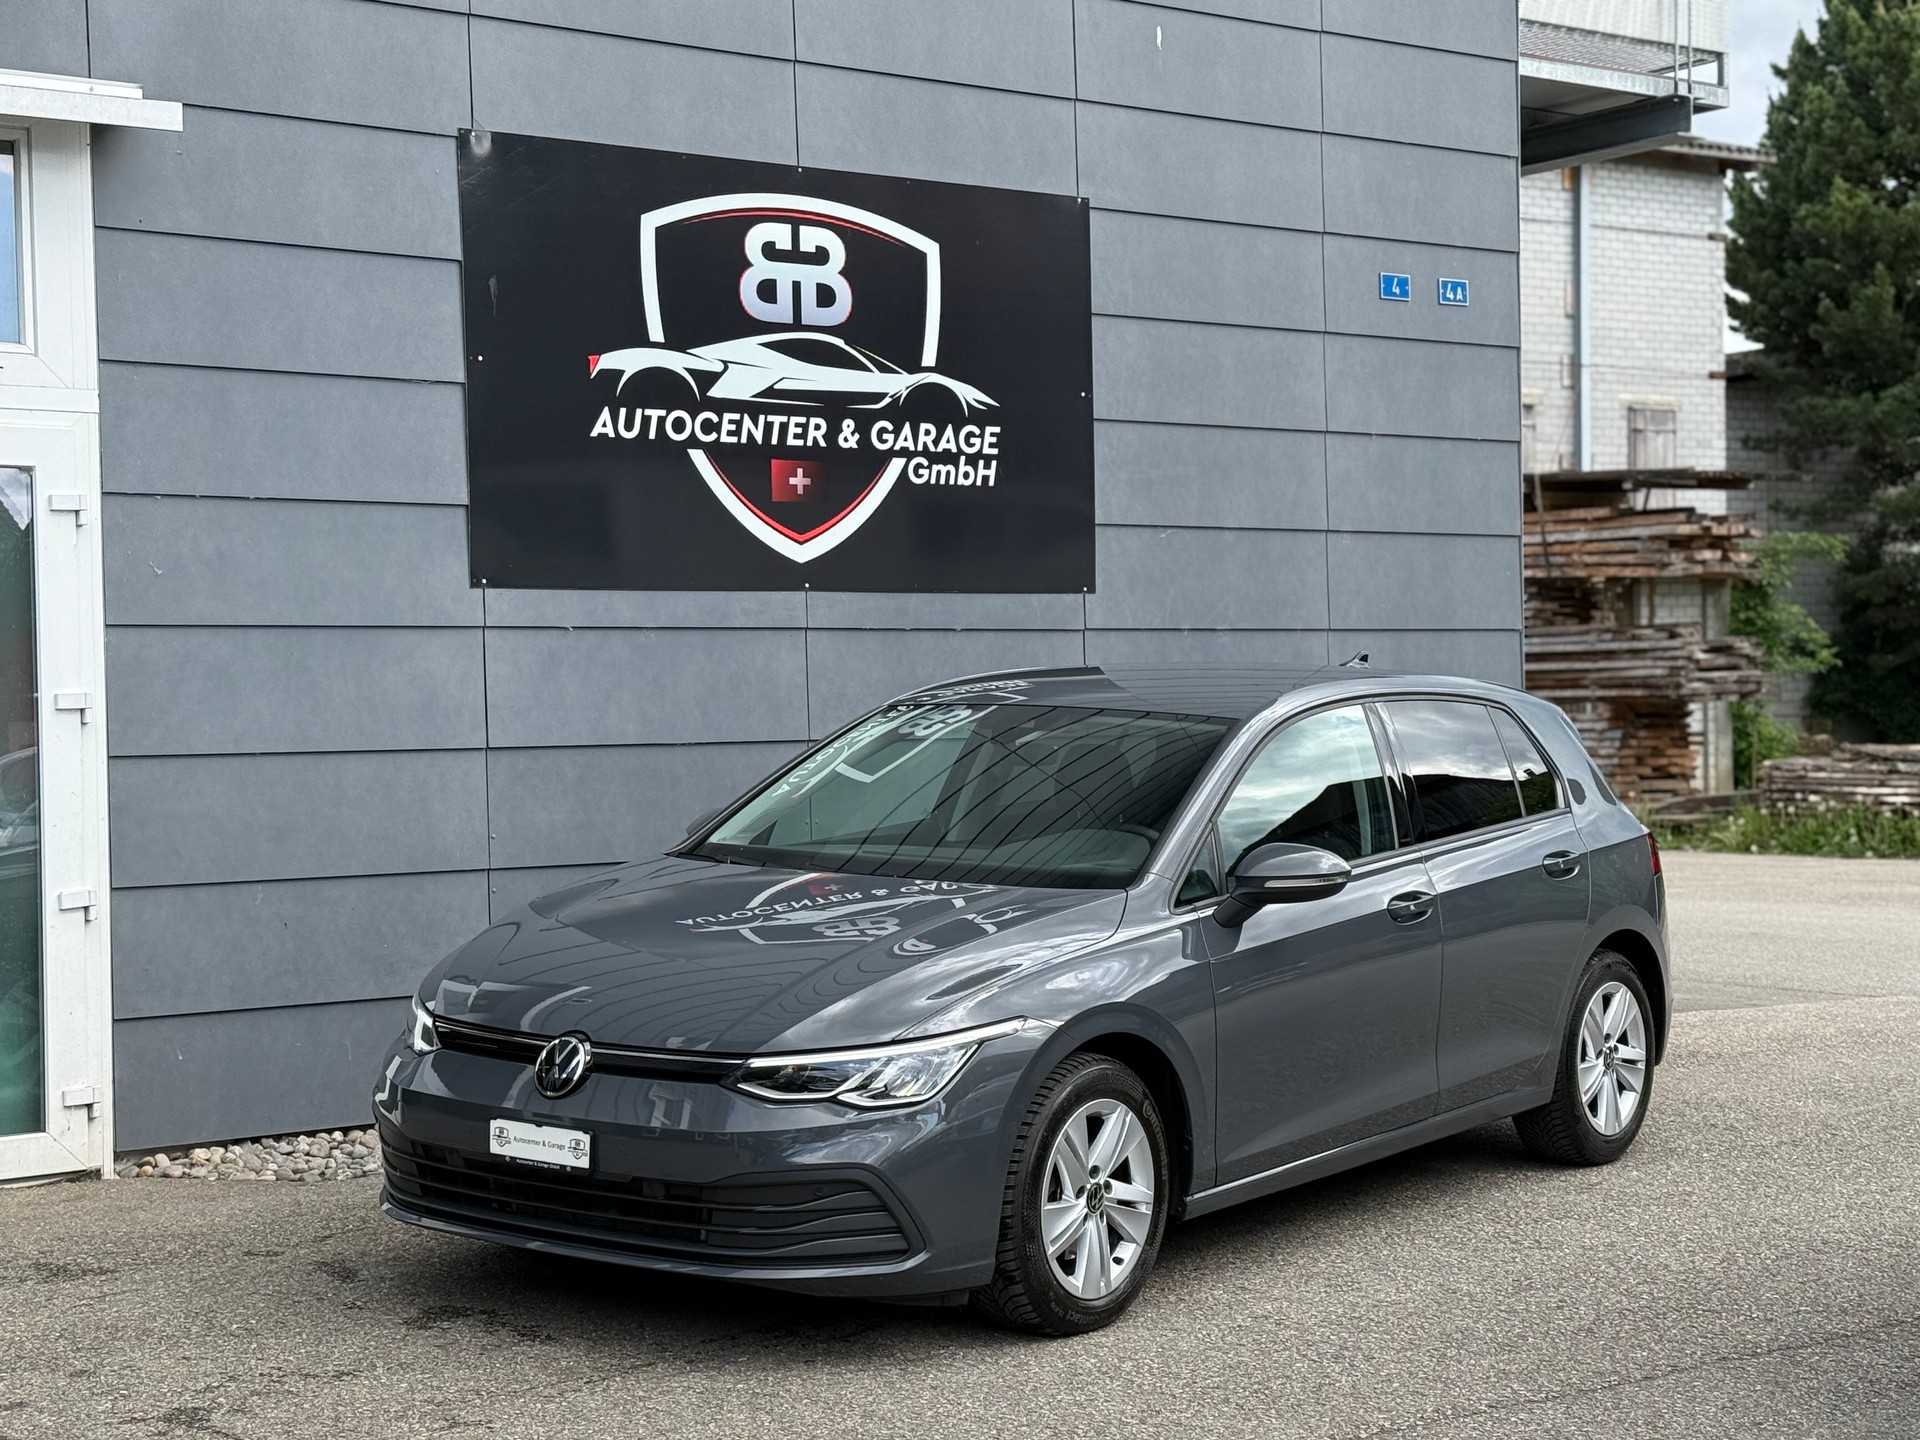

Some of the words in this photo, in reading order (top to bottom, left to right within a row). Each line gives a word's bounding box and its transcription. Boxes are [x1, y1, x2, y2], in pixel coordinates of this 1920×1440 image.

[1392, 277, 1400, 295] 4
[1446, 282, 1463, 301] 4A
[590, 405, 828, 447] AUTOCENTER
[838, 418, 860, 449] &
[870, 420, 1001, 455] GARAGE
[907, 455, 998, 487] GmbH
[513, 1136, 541, 1147] Autocenter
[547, 1141, 566, 1151] Garage
